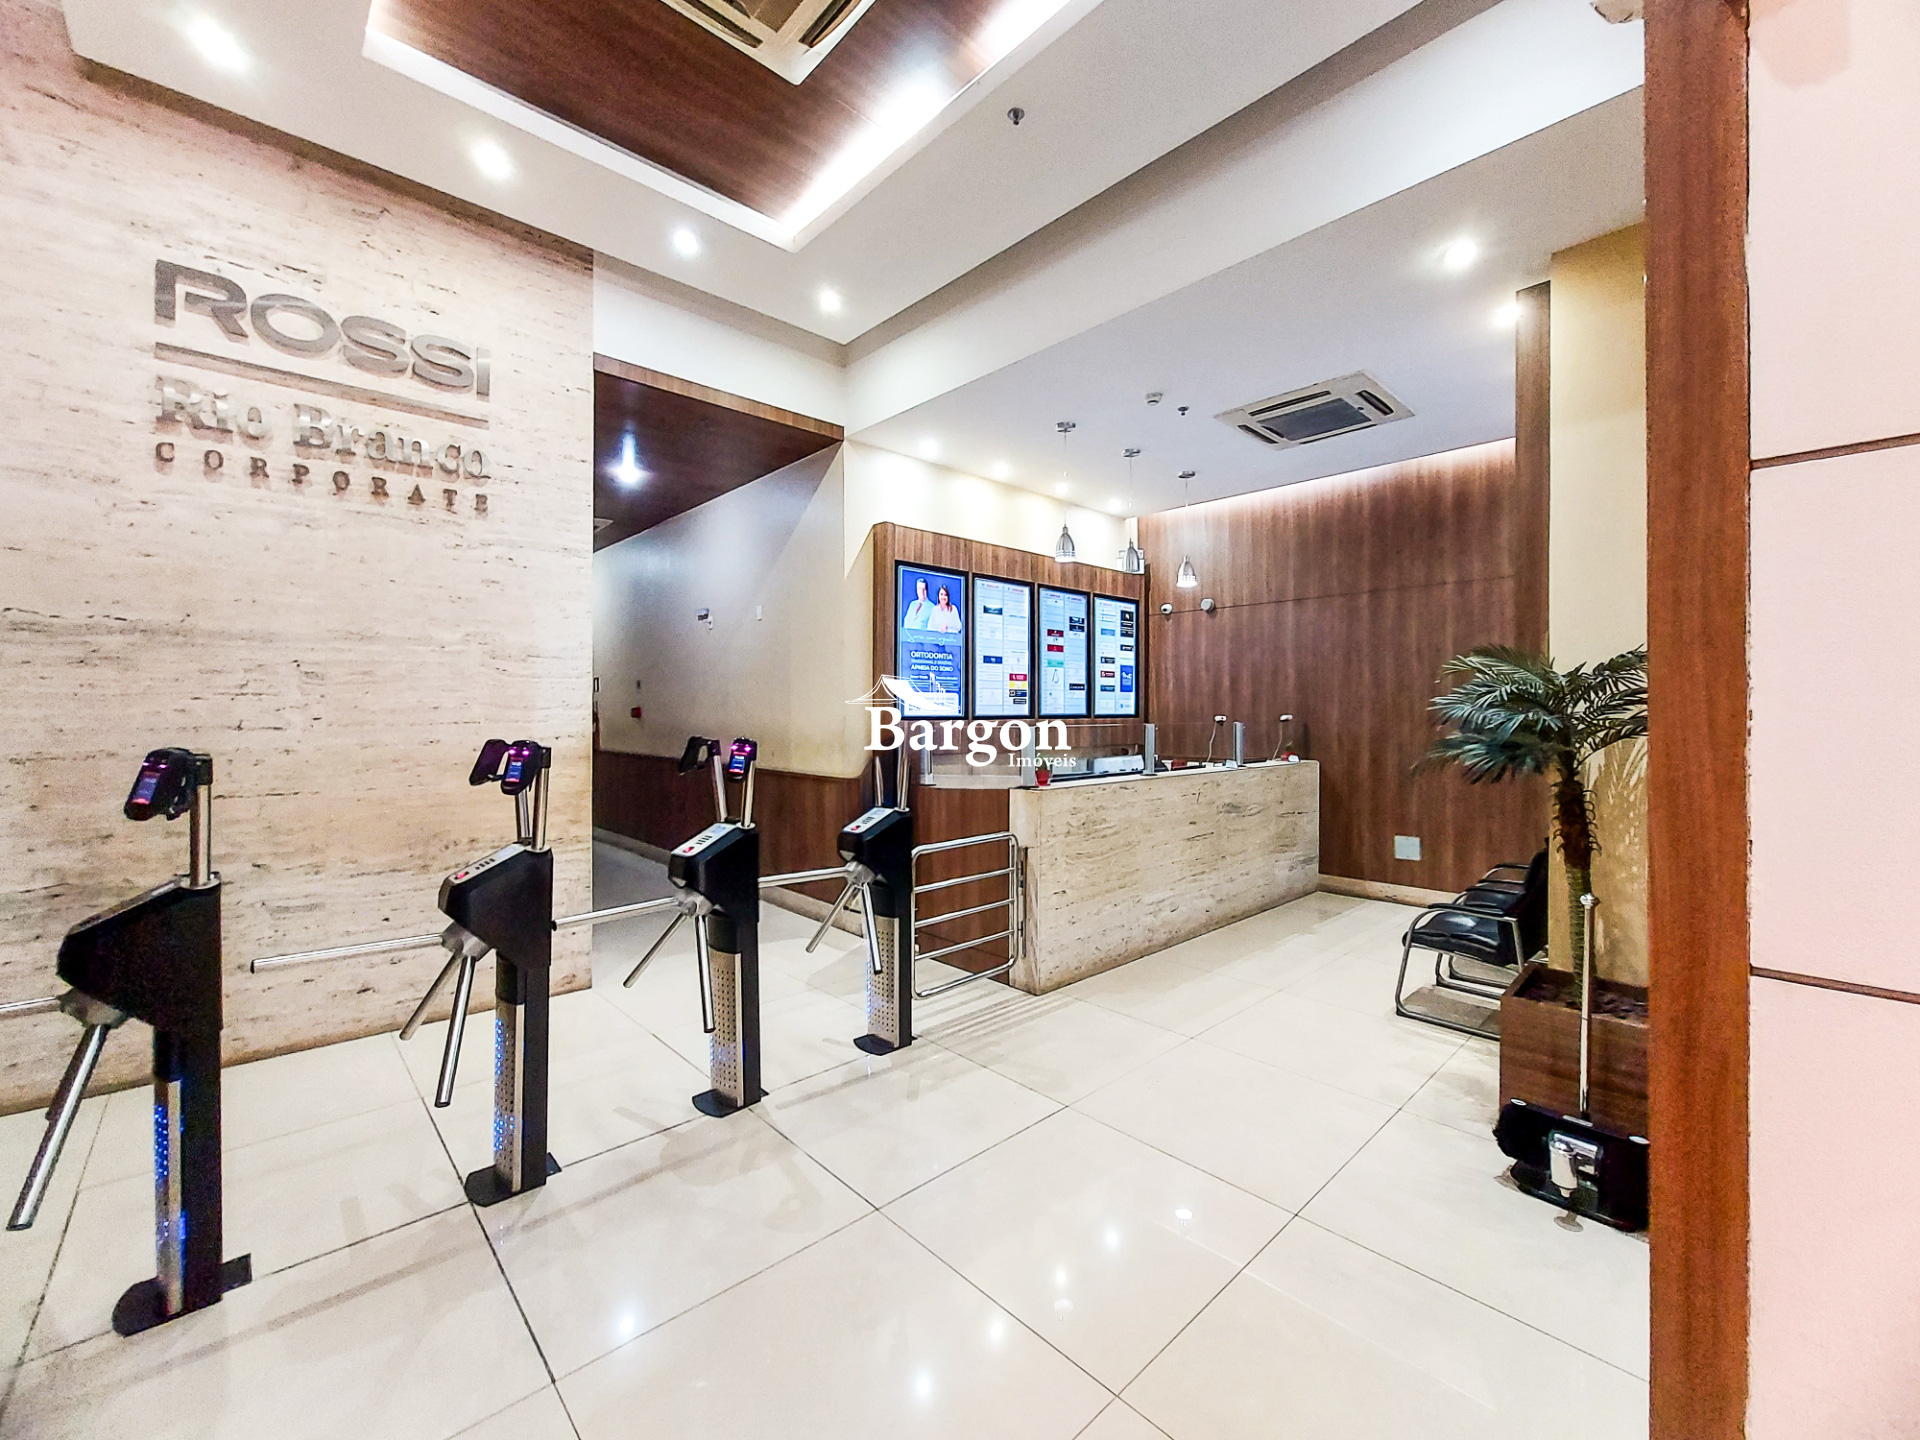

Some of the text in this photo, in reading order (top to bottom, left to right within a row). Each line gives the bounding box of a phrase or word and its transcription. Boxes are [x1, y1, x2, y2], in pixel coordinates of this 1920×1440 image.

[155, 260, 490, 398] ROSSI
[155, 375, 491, 485] Rio Branco
[154, 442, 490, 514] CORPORATE
[911, 651, 953, 660] ORTODONTIA
